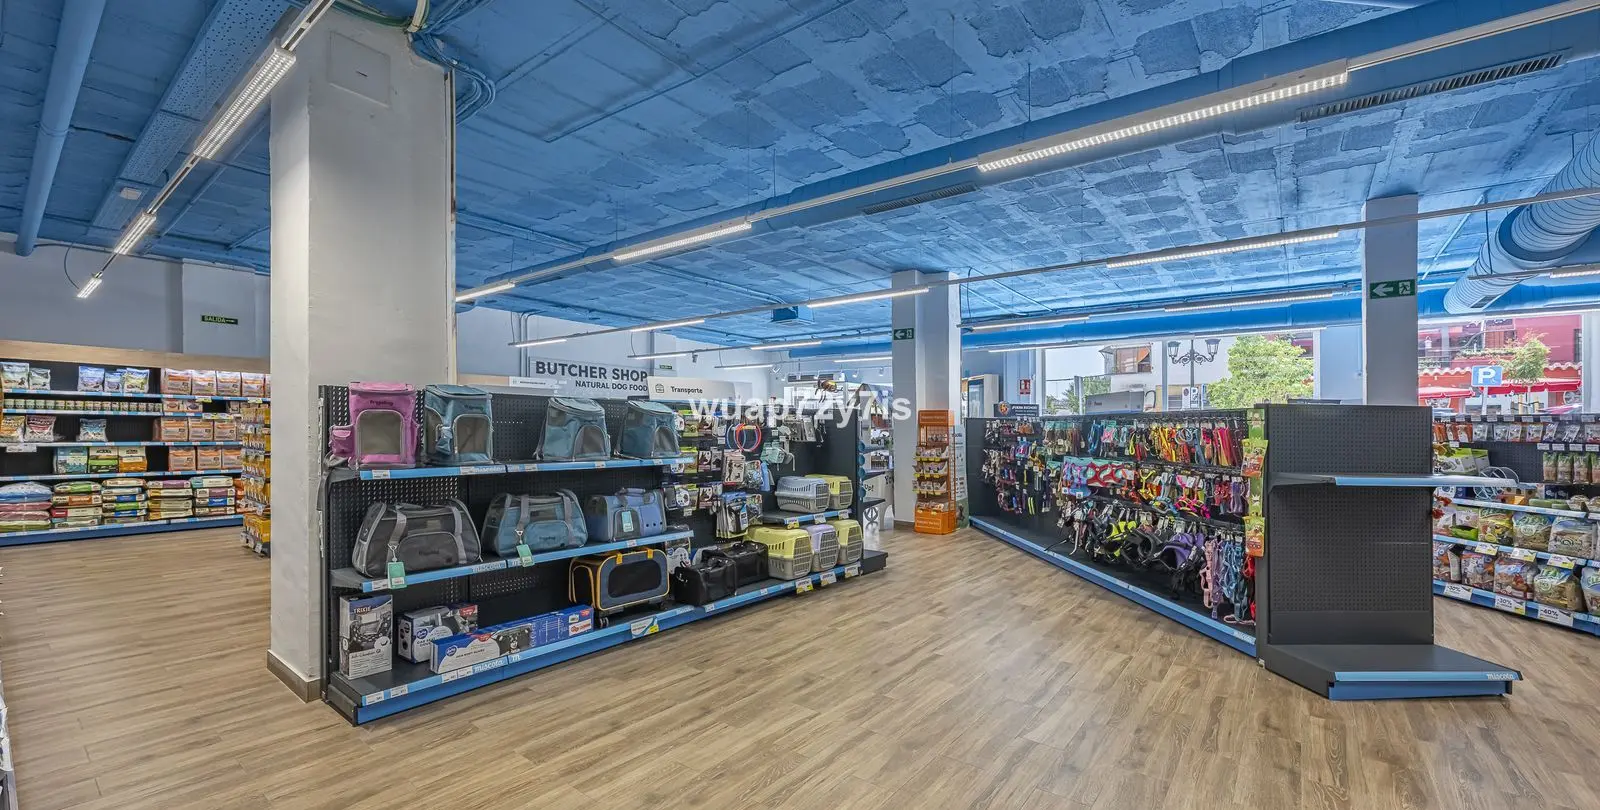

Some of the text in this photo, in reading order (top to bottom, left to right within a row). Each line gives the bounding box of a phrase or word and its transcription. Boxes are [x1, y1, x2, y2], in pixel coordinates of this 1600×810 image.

[204, 315, 226, 323] SALIDA
[535, 361, 648, 382] BUTCHER SHOP
[1478, 368, 1496, 384] P
[575, 380, 648, 392] NATURAL DOG FOOD
[670, 386, 703, 395] Transporte
[1540, 608, 1559, 617] -40%
[473, 660, 503, 673] miscota
[1487, 671, 1513, 681] miscota
